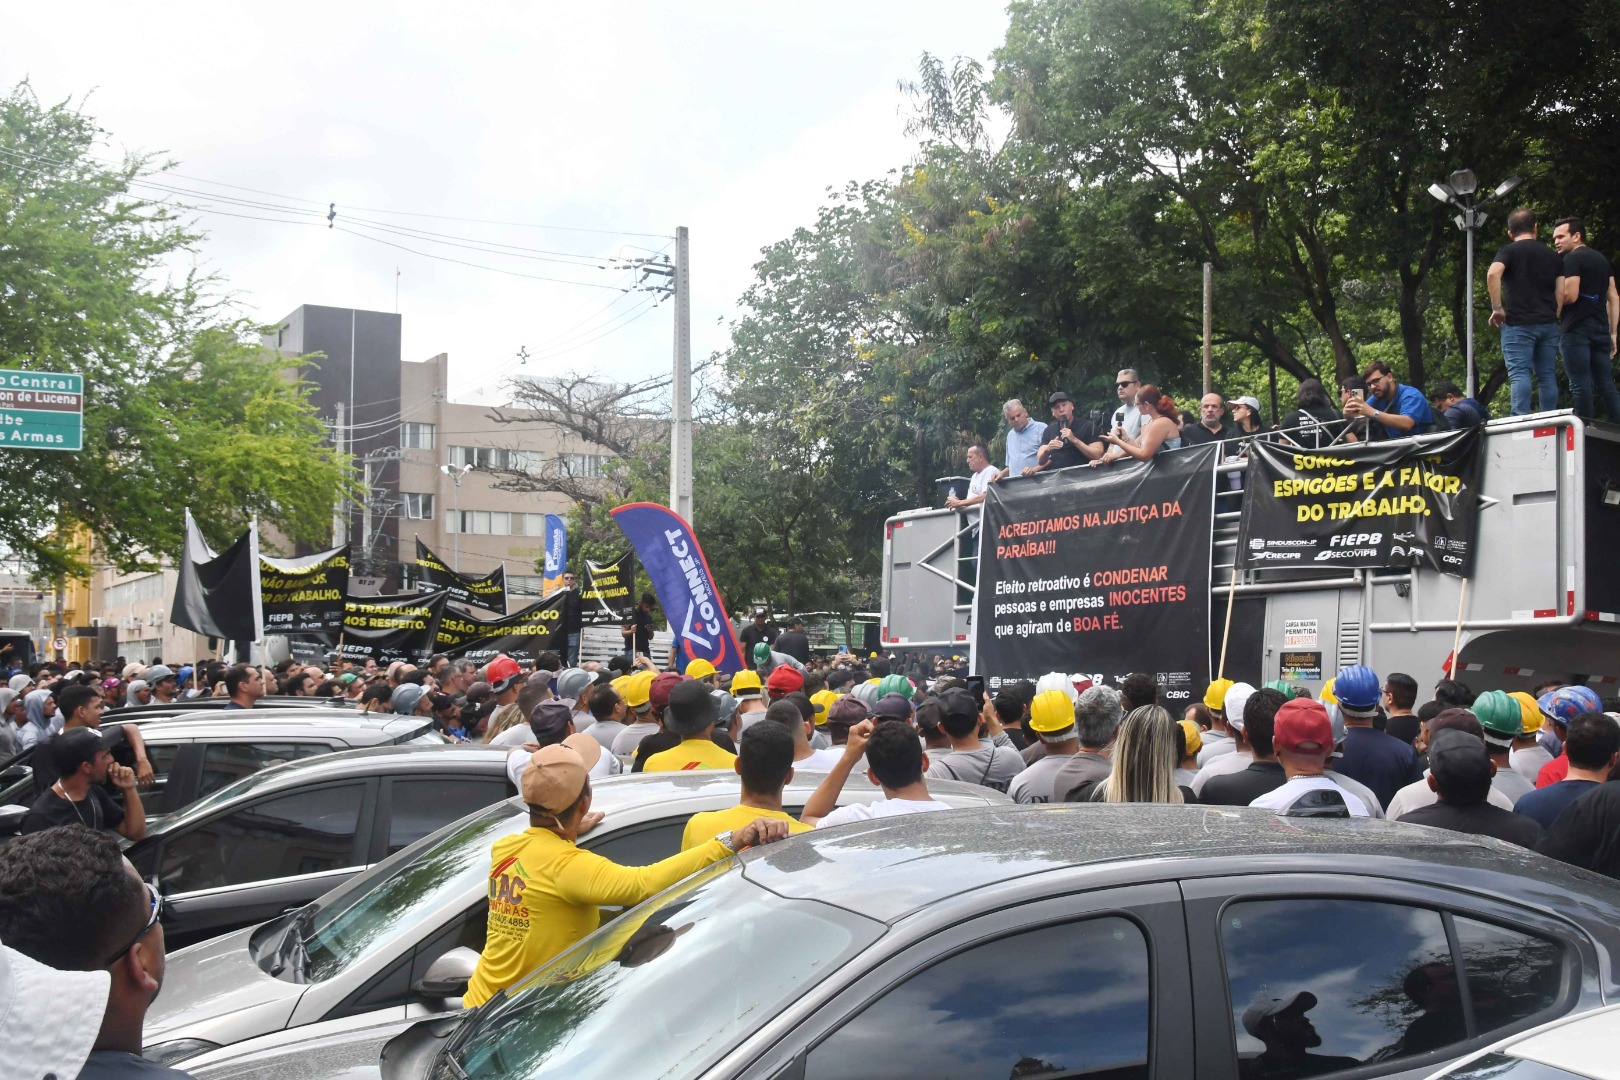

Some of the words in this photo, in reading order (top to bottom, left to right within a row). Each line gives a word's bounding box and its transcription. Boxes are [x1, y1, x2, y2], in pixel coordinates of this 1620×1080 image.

[10, 375, 73, 390] Central
[17, 391, 32, 402] de
[35, 392, 77, 405] Lucena
[11, 430, 64, 443] Armas
[1274, 472, 1359, 497] ESPIGÕES
[1363, 471, 1376, 490] E
[1381, 470, 1395, 488] A
[1296, 504, 1324, 522] DO
[1327, 495, 1431, 520] TRABALHO.
[998, 514, 1080, 539] ACREDITAMOS
[1083, 512, 1101, 529] NA
[1103, 503, 1160, 526] JUSTIÇA
[1162, 501, 1183, 518] DA
[996, 540, 1057, 560] PARAÍBA!!!
[1265, 552, 1302, 560] CRECIPB
[1330, 551, 1378, 560] SECOVIPB
[664, 528, 721, 636] CONNECT
[995, 579, 1026, 596] Efeito
[1028, 575, 1081, 592] retroativo
[1083, 573, 1091, 588] é
[1093, 565, 1169, 588] CONDENAR
[994, 602, 1038, 618] pessoas
[1039, 600, 1048, 613] e
[1049, 594, 1105, 613] empresas
[1108, 585, 1187, 607] INOCENTES
[359, 604, 432, 618] TRABALHAR,
[369, 618, 427, 630] RESPEITO.
[994, 624, 1014, 639] que
[1016, 620, 1054, 639] agiram
[1056, 617, 1073, 634] de
[1073, 615, 1101, 632] BOA
[1103, 611, 1125, 630] FÉ.
[1166, 690, 1191, 699] CBIC
